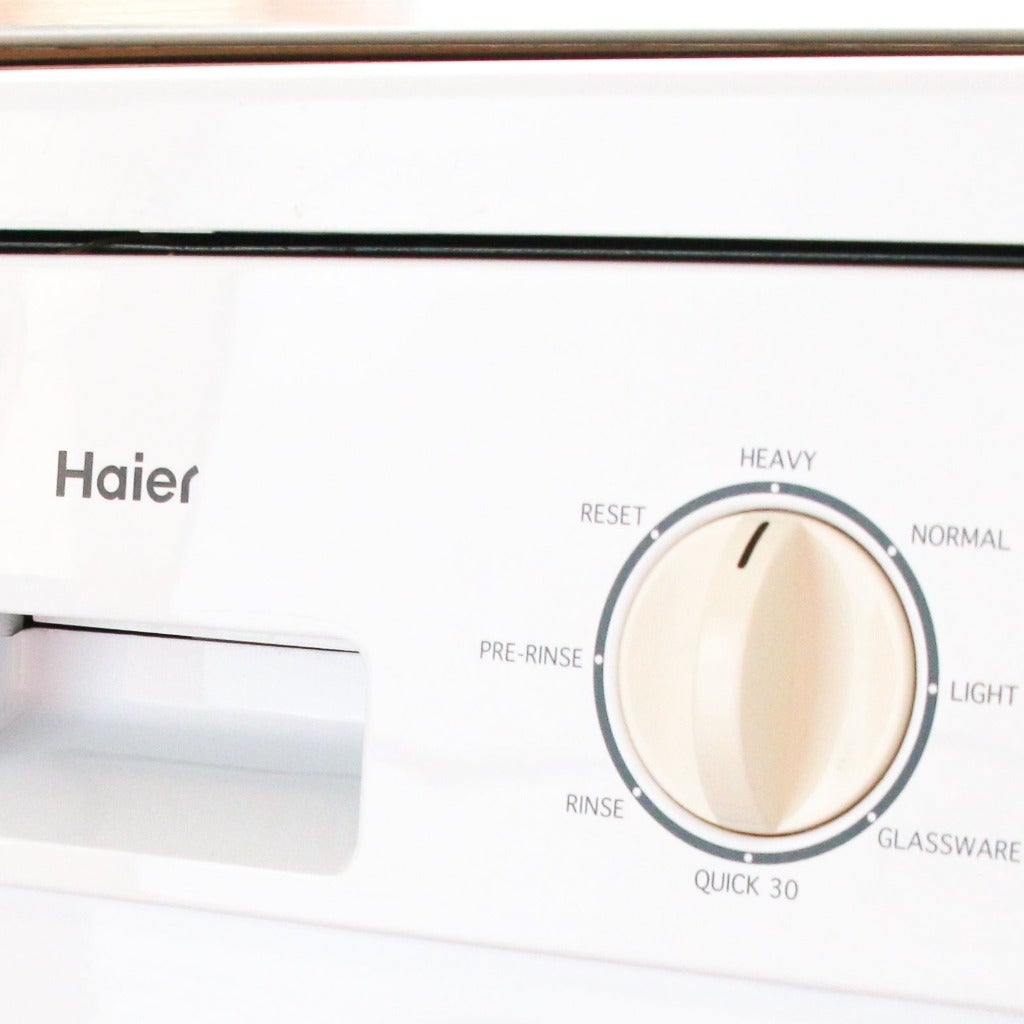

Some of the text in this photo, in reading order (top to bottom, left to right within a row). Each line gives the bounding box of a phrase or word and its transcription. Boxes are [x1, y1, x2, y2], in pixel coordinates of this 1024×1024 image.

[740, 447, 817, 471] HEAVY
[56, 450, 199, 504] Haier
[580, 502, 647, 527] RESET
[911, 524, 1010, 552] NORMAL
[479, 640, 583, 669] PRE-RINSE
[950, 680, 1019, 706] LIGHT
[565, 793, 625, 819] RINSE
[877, 827, 1022, 863] GLASSWARE
[694, 868, 799, 901] QUICK 30
